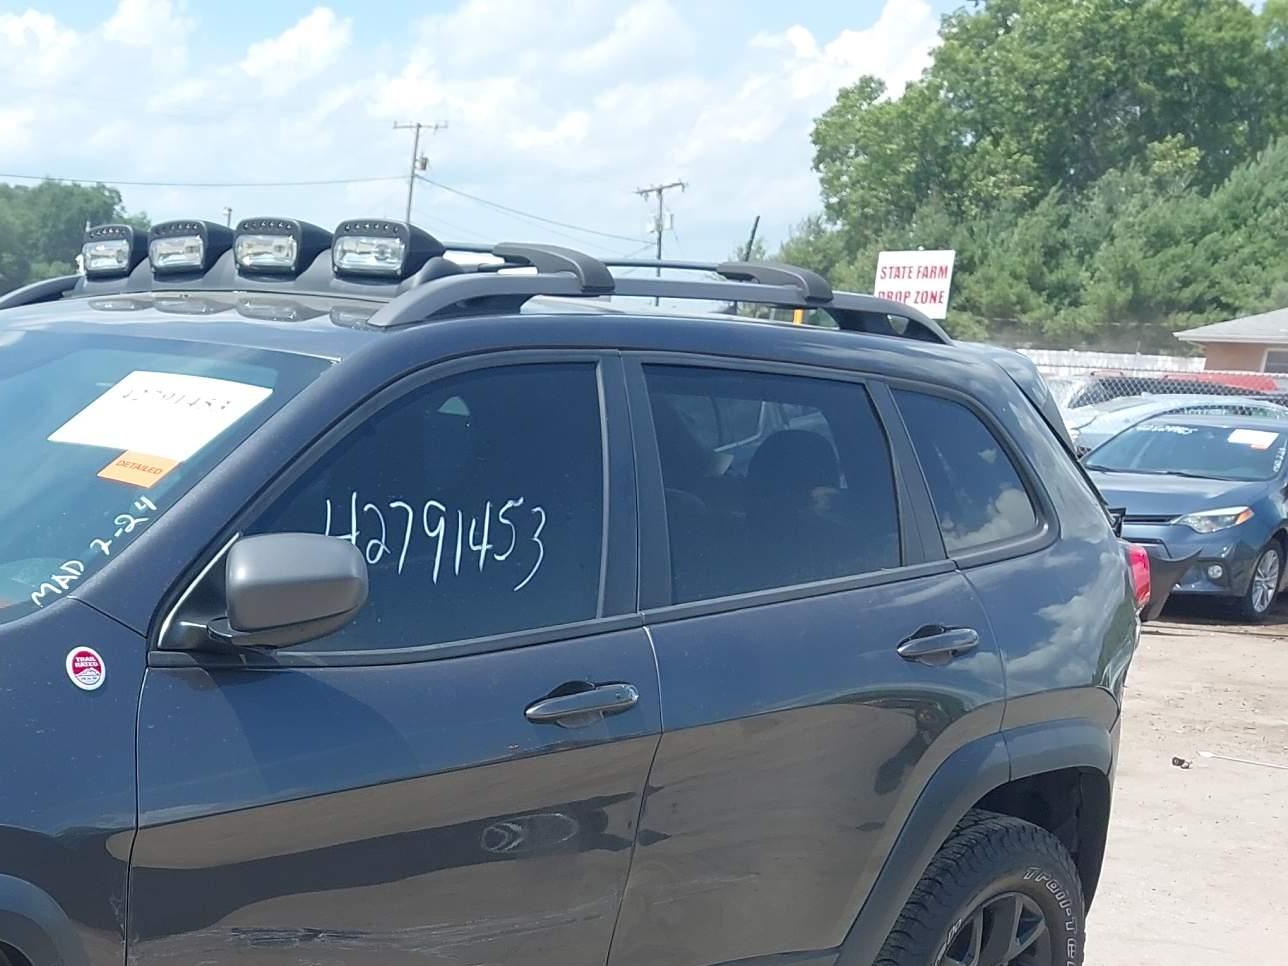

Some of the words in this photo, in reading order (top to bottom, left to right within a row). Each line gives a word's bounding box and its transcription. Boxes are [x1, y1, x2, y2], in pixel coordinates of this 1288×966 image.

[880, 265, 913, 280] STATE
[916, 264, 949, 279] FARM
[913, 290, 945, 304] ZONE
[116, 459, 162, 475] DETAILED
[325, 491, 546, 592] 42791453
[31, 560, 85, 608] MAD
